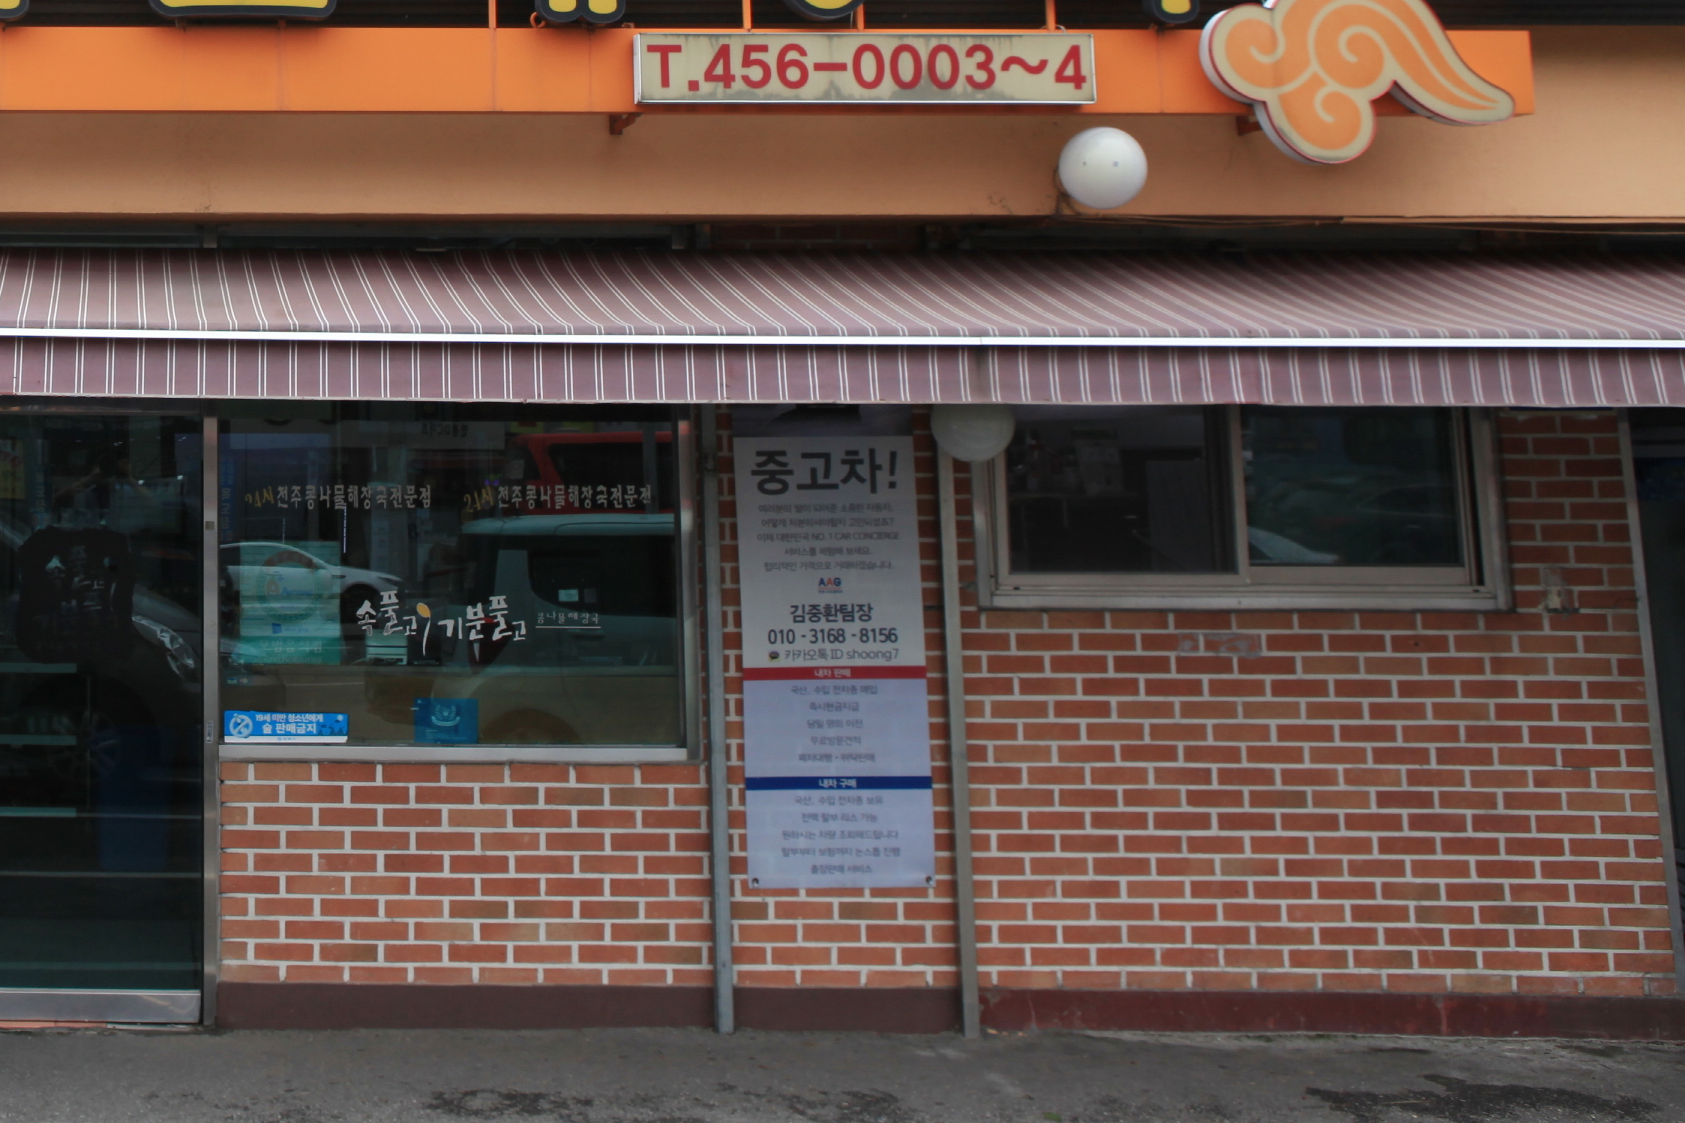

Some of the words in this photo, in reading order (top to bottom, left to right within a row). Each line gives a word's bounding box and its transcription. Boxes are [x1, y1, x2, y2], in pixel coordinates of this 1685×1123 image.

[647, 42, 1087, 92] T.456-0003~4
[751, 448, 898, 495] 중고차!
[277, 485, 431, 509] 전주콩나물해장국전문점
[757, 532, 774, 542] 이제
[776, 532, 810, 542] 대한민국
[834, 532, 852, 542] CAR
[784, 546, 817, 556] 서비스를
[800, 561, 832, 572] 가격으로
[818, 577, 842, 587] AAG
[356, 590, 418, 637] 속풀고
[437, 595, 527, 641] 기분풀고
[790, 603, 873, 623] 김중환팀장
[785, 649, 829, 662] 카카오톡
[830, 648, 844, 659] ID
[846, 648, 899, 662] shoong7
[814, 668, 832, 678] 내차
[833, 668, 852, 678] 판매
[813, 685, 830, 695] 수입
[255, 713, 271, 723] 19세
[272, 713, 286, 723] 미만
[288, 713, 324, 723] 청소년에게
[262, 723, 273, 734] 술
[276, 723, 317, 735] 판매금지
[845, 719, 863, 729] 이전
[819, 778, 837, 788] 내차
[839, 778, 858, 788] 구매
[818, 795, 836, 806] 수입
[865, 795, 883, 806] 보유
[840, 813, 858, 823] 리스
[860, 813, 878, 823] 가능
[782, 830, 817, 841] 원하시는
[819, 830, 836, 841] 차량
[847, 864, 873, 875] 서비스
